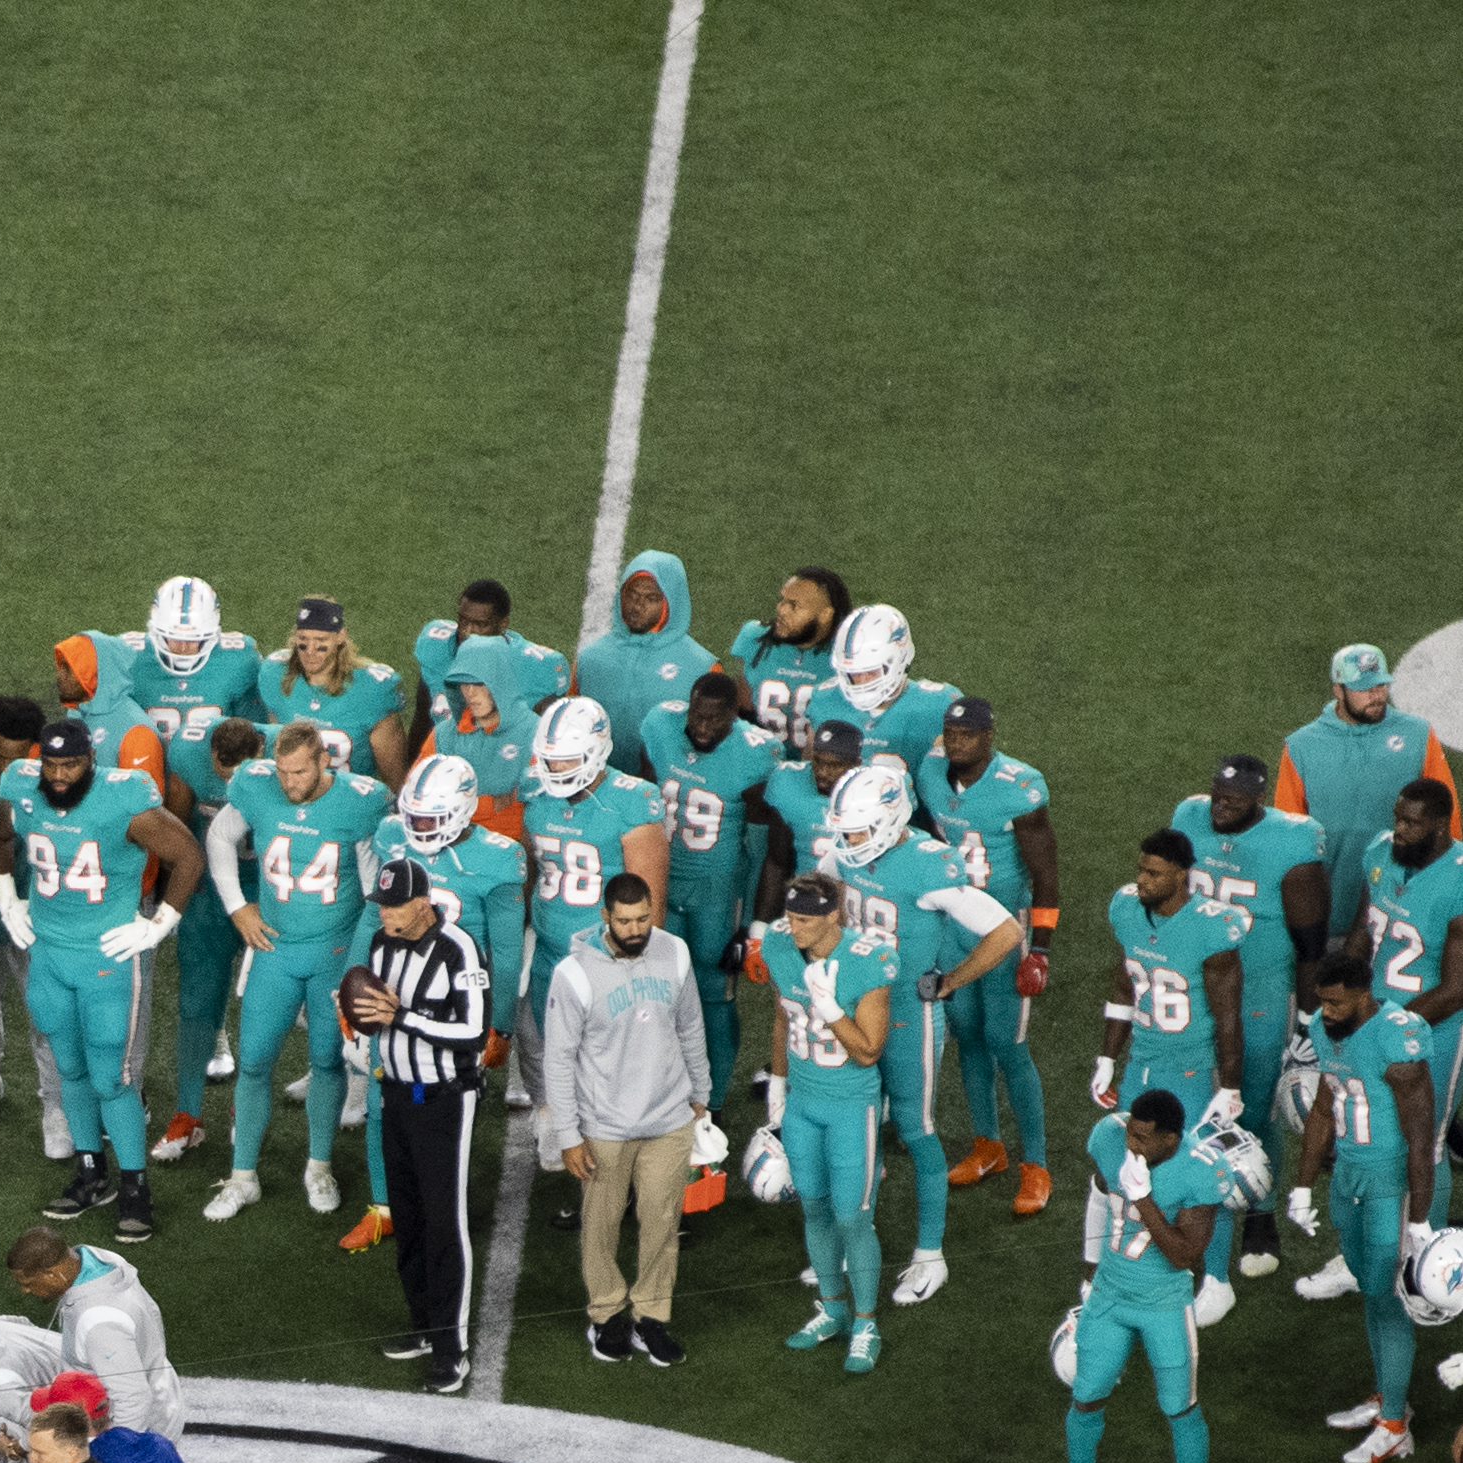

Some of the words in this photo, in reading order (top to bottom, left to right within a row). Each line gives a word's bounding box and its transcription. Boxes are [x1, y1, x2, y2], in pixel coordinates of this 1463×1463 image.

[27, 831, 108, 904] 94
[262, 834, 341, 905] 44
[533, 833, 604, 907] 58
[957, 830, 993, 889] 4
[460, 971, 489, 988] 115
[1368, 903, 1425, 993] 72
[1124, 958, 1192, 1034] 26
